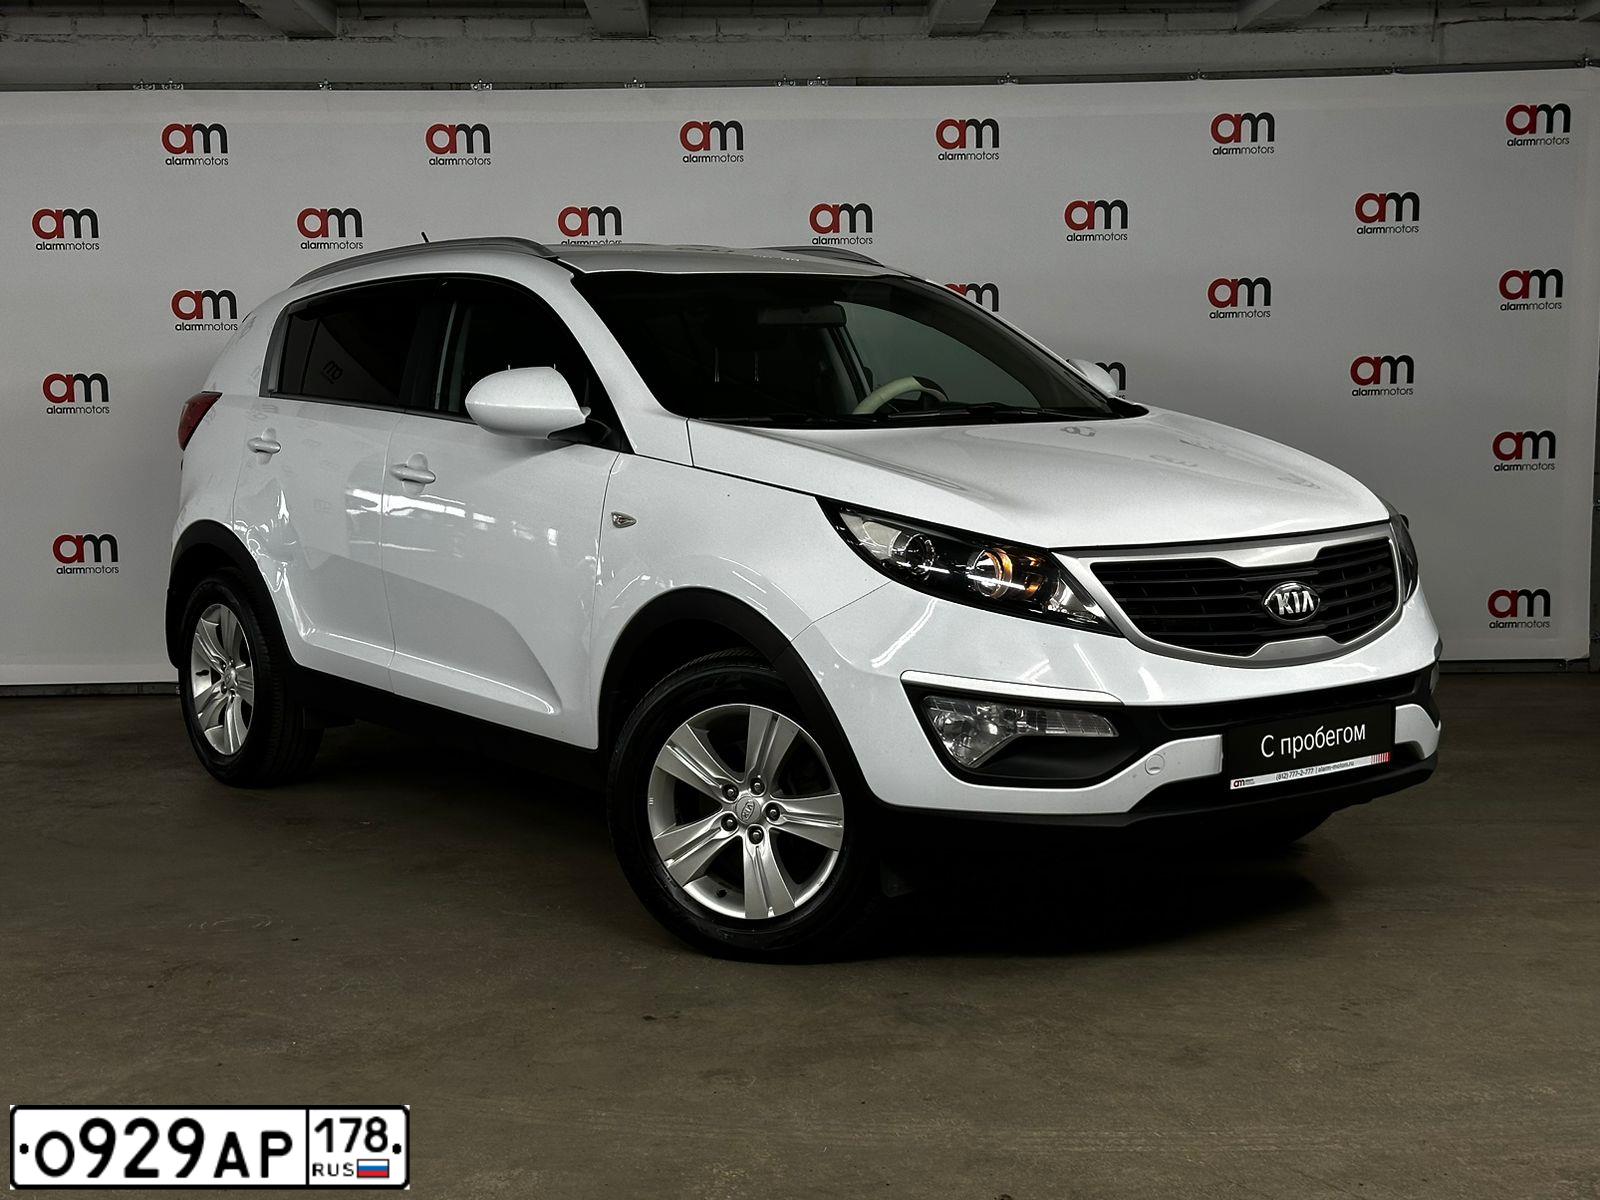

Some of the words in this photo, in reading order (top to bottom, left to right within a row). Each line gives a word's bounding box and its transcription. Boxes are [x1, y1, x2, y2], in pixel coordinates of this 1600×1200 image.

[1211, 112, 1275, 144] am
[1506, 103, 1571, 135] am
[162, 123, 228, 155] am
[426, 124, 490, 155] am
[680, 120, 743, 152] am
[936, 118, 999, 150] am
[1507, 136, 1569, 147] alarmmotors
[165, 155, 228, 166] alarmmotors
[429, 155, 491, 166] alarmmotors
[682, 152, 744, 164] alarmmotors
[938, 150, 999, 161] alarmmotors
[1212, 145, 1274, 156] alarmmotors
[809, 203, 873, 234] am
[1064, 200, 1128, 231] am
[1355, 192, 1420, 223] am
[32, 209, 99, 240] am
[297, 208, 363, 238] am
[558, 206, 622, 237] am
[1357, 223, 1419, 235] alarmmotors
[36, 241, 99, 251] alarmmotors
[301, 239, 363, 250] alarmmotors
[812, 235, 873, 246] alarmmotors
[1066, 231, 1127, 242] alarmmotors
[1208, 277, 1271, 308] am
[1499, 269, 1563, 300] am
[171, 290, 237, 320] am
[1209, 308, 1271, 320] alarmmotors
[1500, 301, 1562, 312] alarmmotors
[175, 321, 238, 332] alarmmotors
[1350, 355, 1414, 386] am
[43, 373, 109, 403] am
[1352, 386, 1413, 397] alarmmotors
[46, 404, 109, 415] alarmmotors
[1492, 430, 1556, 461] am
[1494, 462, 1555, 472] alarmmotors
[53, 534, 118, 564] am
[56, 565, 119, 575] alarmmotors
[1275, 590, 1314, 615] KIA
[1488, 589, 1550, 618] am
[1489, 619, 1550, 629] alarmmotors
[1260, 735, 1275, 758] С
[1281, 724, 1366, 759] пробегом
[1289, 767, 1314, 779] 777-2-777
[741, 800, 755, 820] KIA
